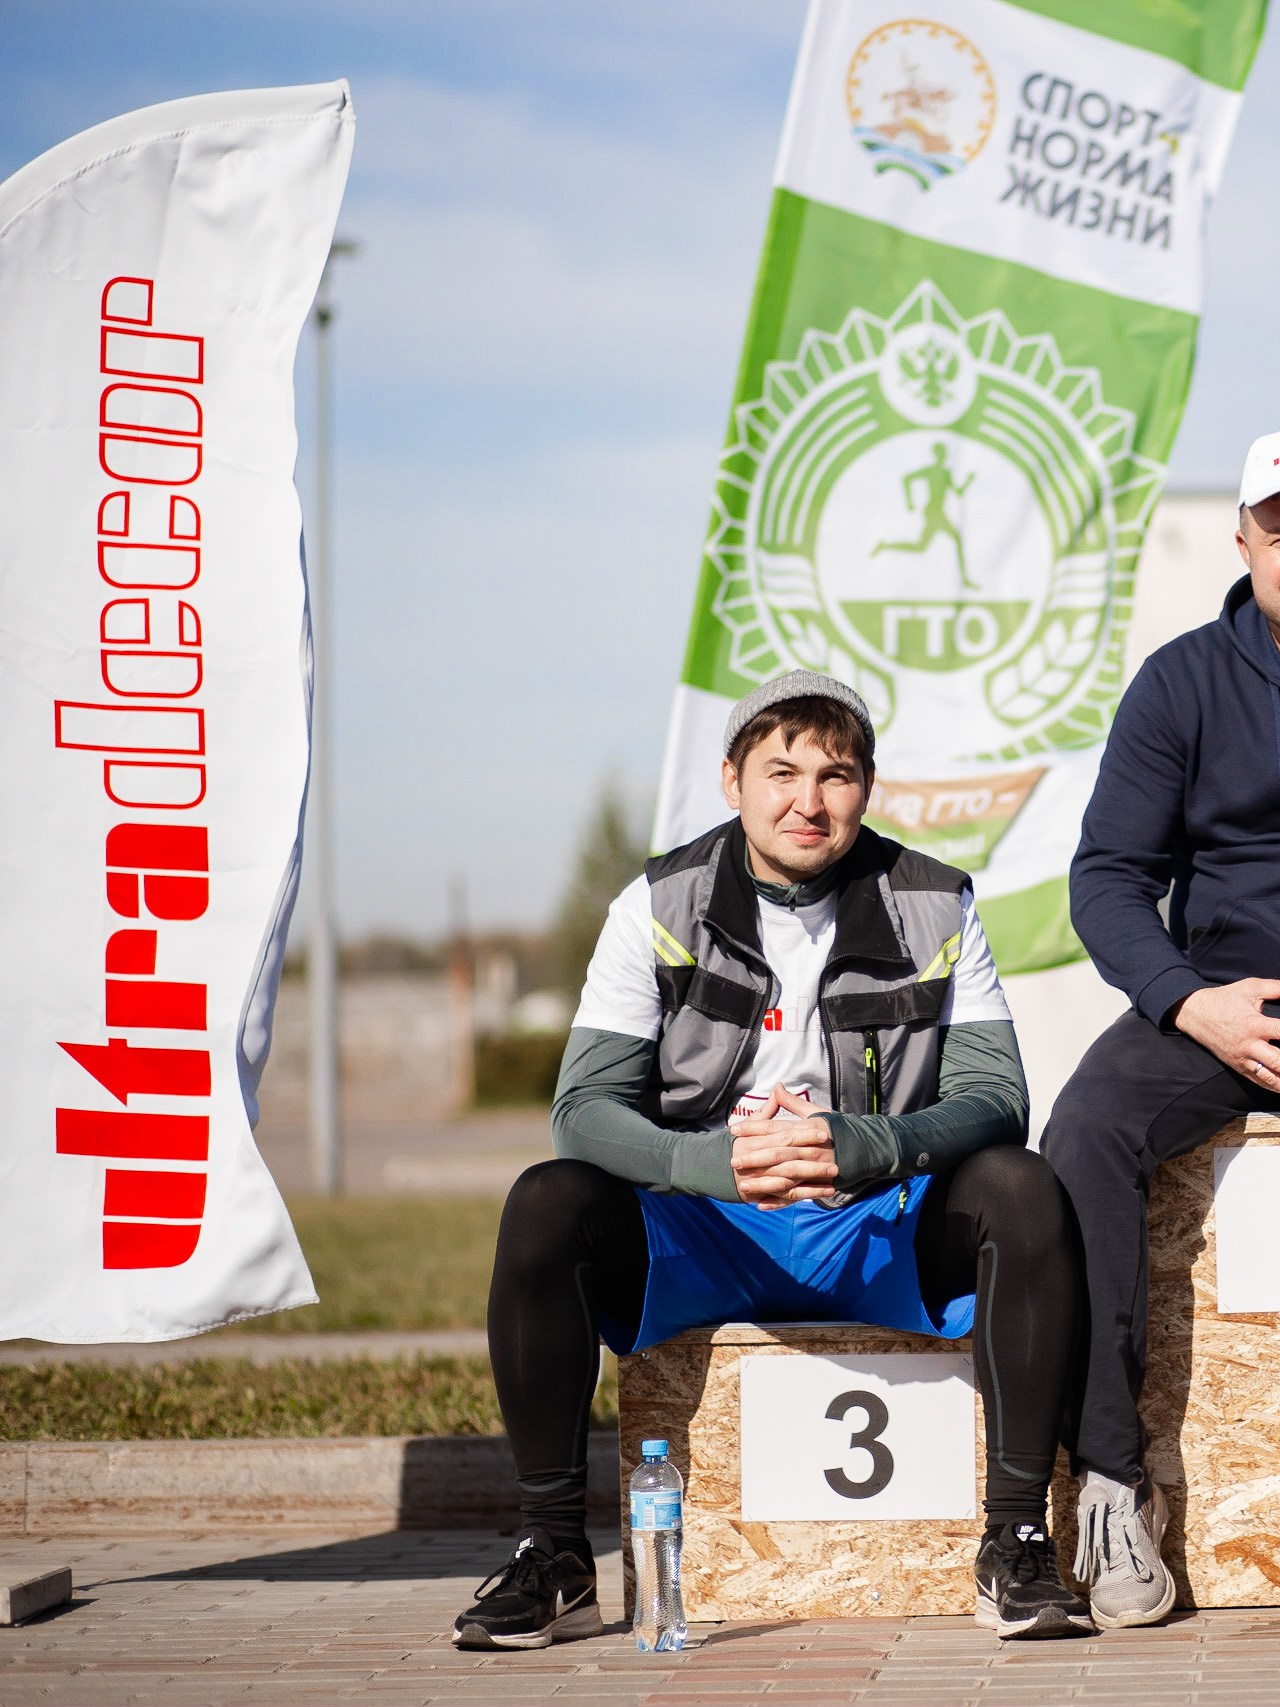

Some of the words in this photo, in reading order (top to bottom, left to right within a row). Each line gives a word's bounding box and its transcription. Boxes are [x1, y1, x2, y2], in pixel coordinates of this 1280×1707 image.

[1021, 71, 1162, 147] СПОРТ
[1008, 114, 1174, 203] НОРМА
[999, 162, 1172, 250] ЖИЗНИ
[882, 605, 1000, 657] ГТО
[925, 787, 994, 825] ГТО
[823, 1390, 894, 1500] 3
